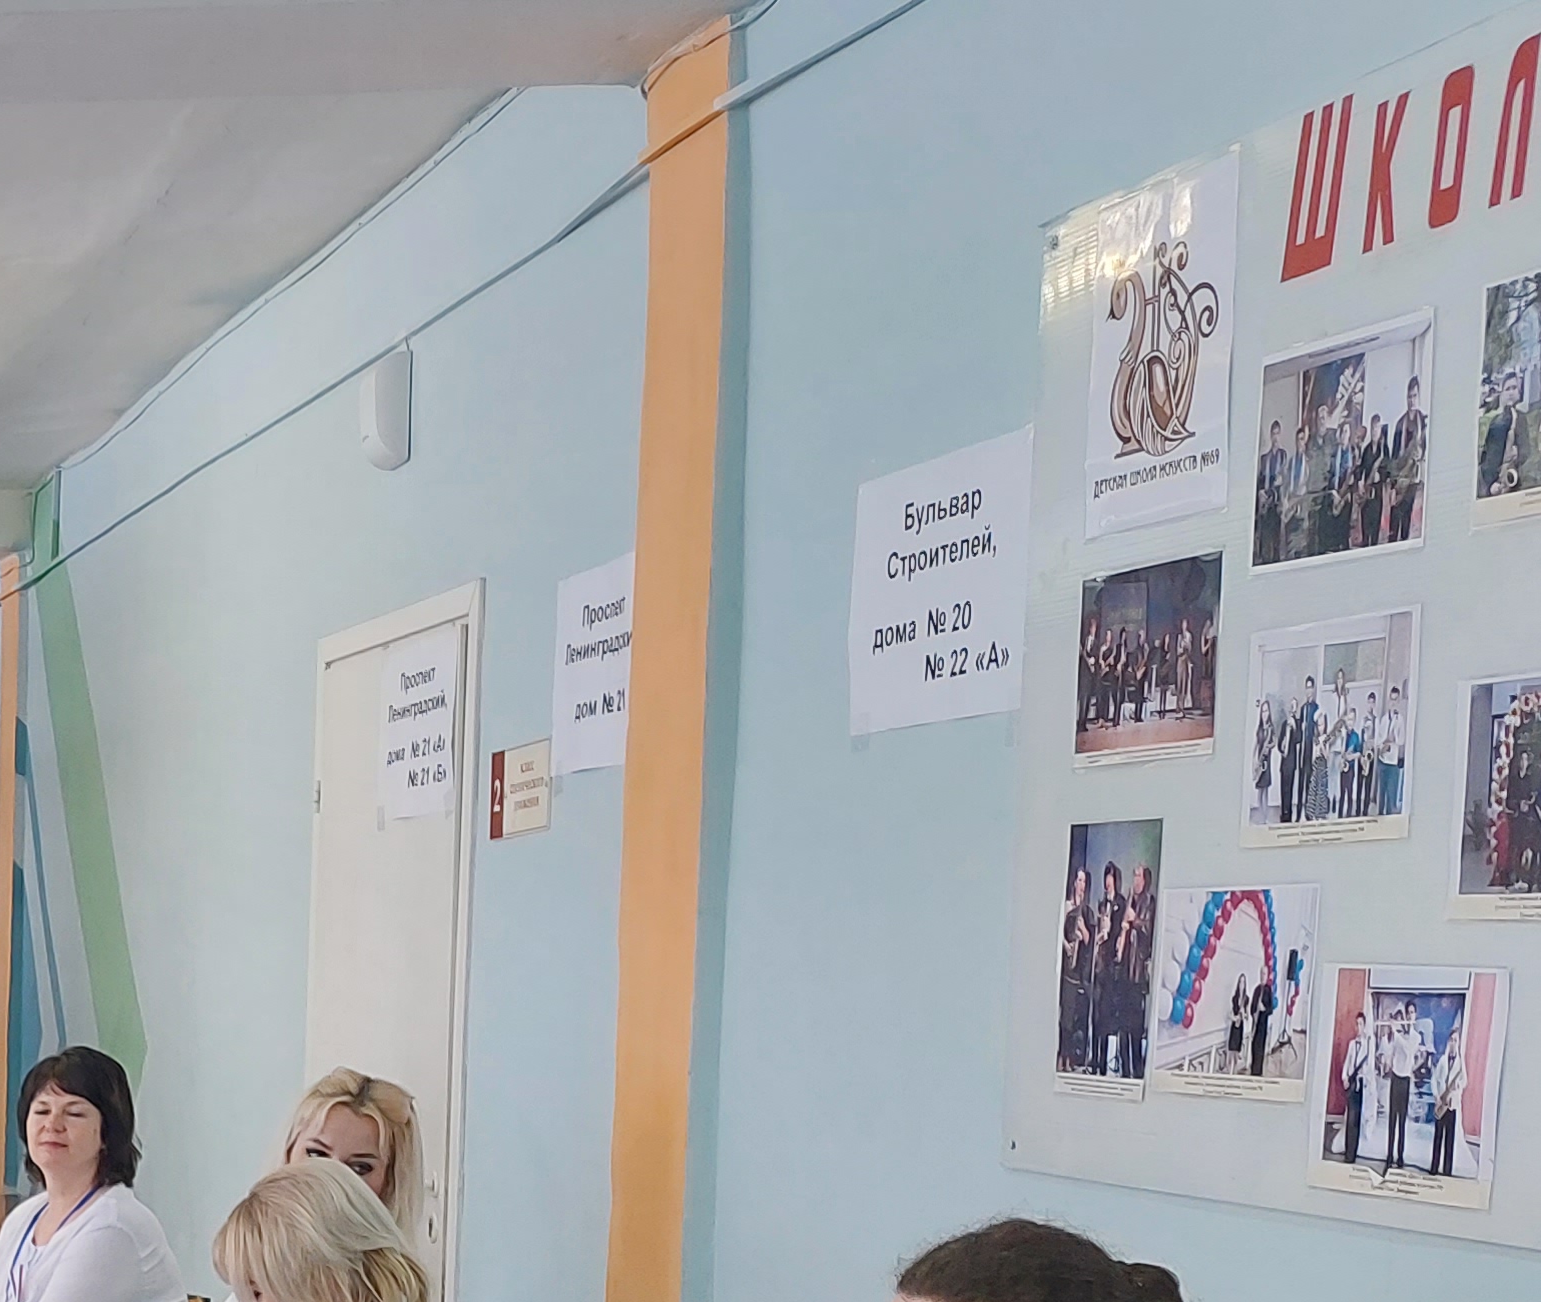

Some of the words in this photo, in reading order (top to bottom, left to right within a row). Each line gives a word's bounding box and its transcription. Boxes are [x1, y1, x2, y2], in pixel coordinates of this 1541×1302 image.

[1093, 472, 1128, 500] ДЕТСКАЯ
[903, 488, 983, 535] Бульвар
[886, 524, 997, 582] Строителей,
[582, 596, 626, 632] Проспект
[872, 620, 917, 656] дома
[927, 606, 947, 637] №
[951, 600, 973, 633] 20
[924, 652, 945, 682] №
[950, 647, 969, 677] 22
[975, 640, 1010, 672] «А»
[400, 667, 436, 695] Проспект
[574, 700, 598, 723] дом
[602, 691, 615, 715] №
[617, 688, 626, 711] 21
[386, 747, 406, 767] дома
[410, 740, 420, 760] №
[421, 736, 431, 757] 21
[407, 768, 419, 788] №
[420, 766, 431, 786] 21
[493, 778, 501, 813] 2
